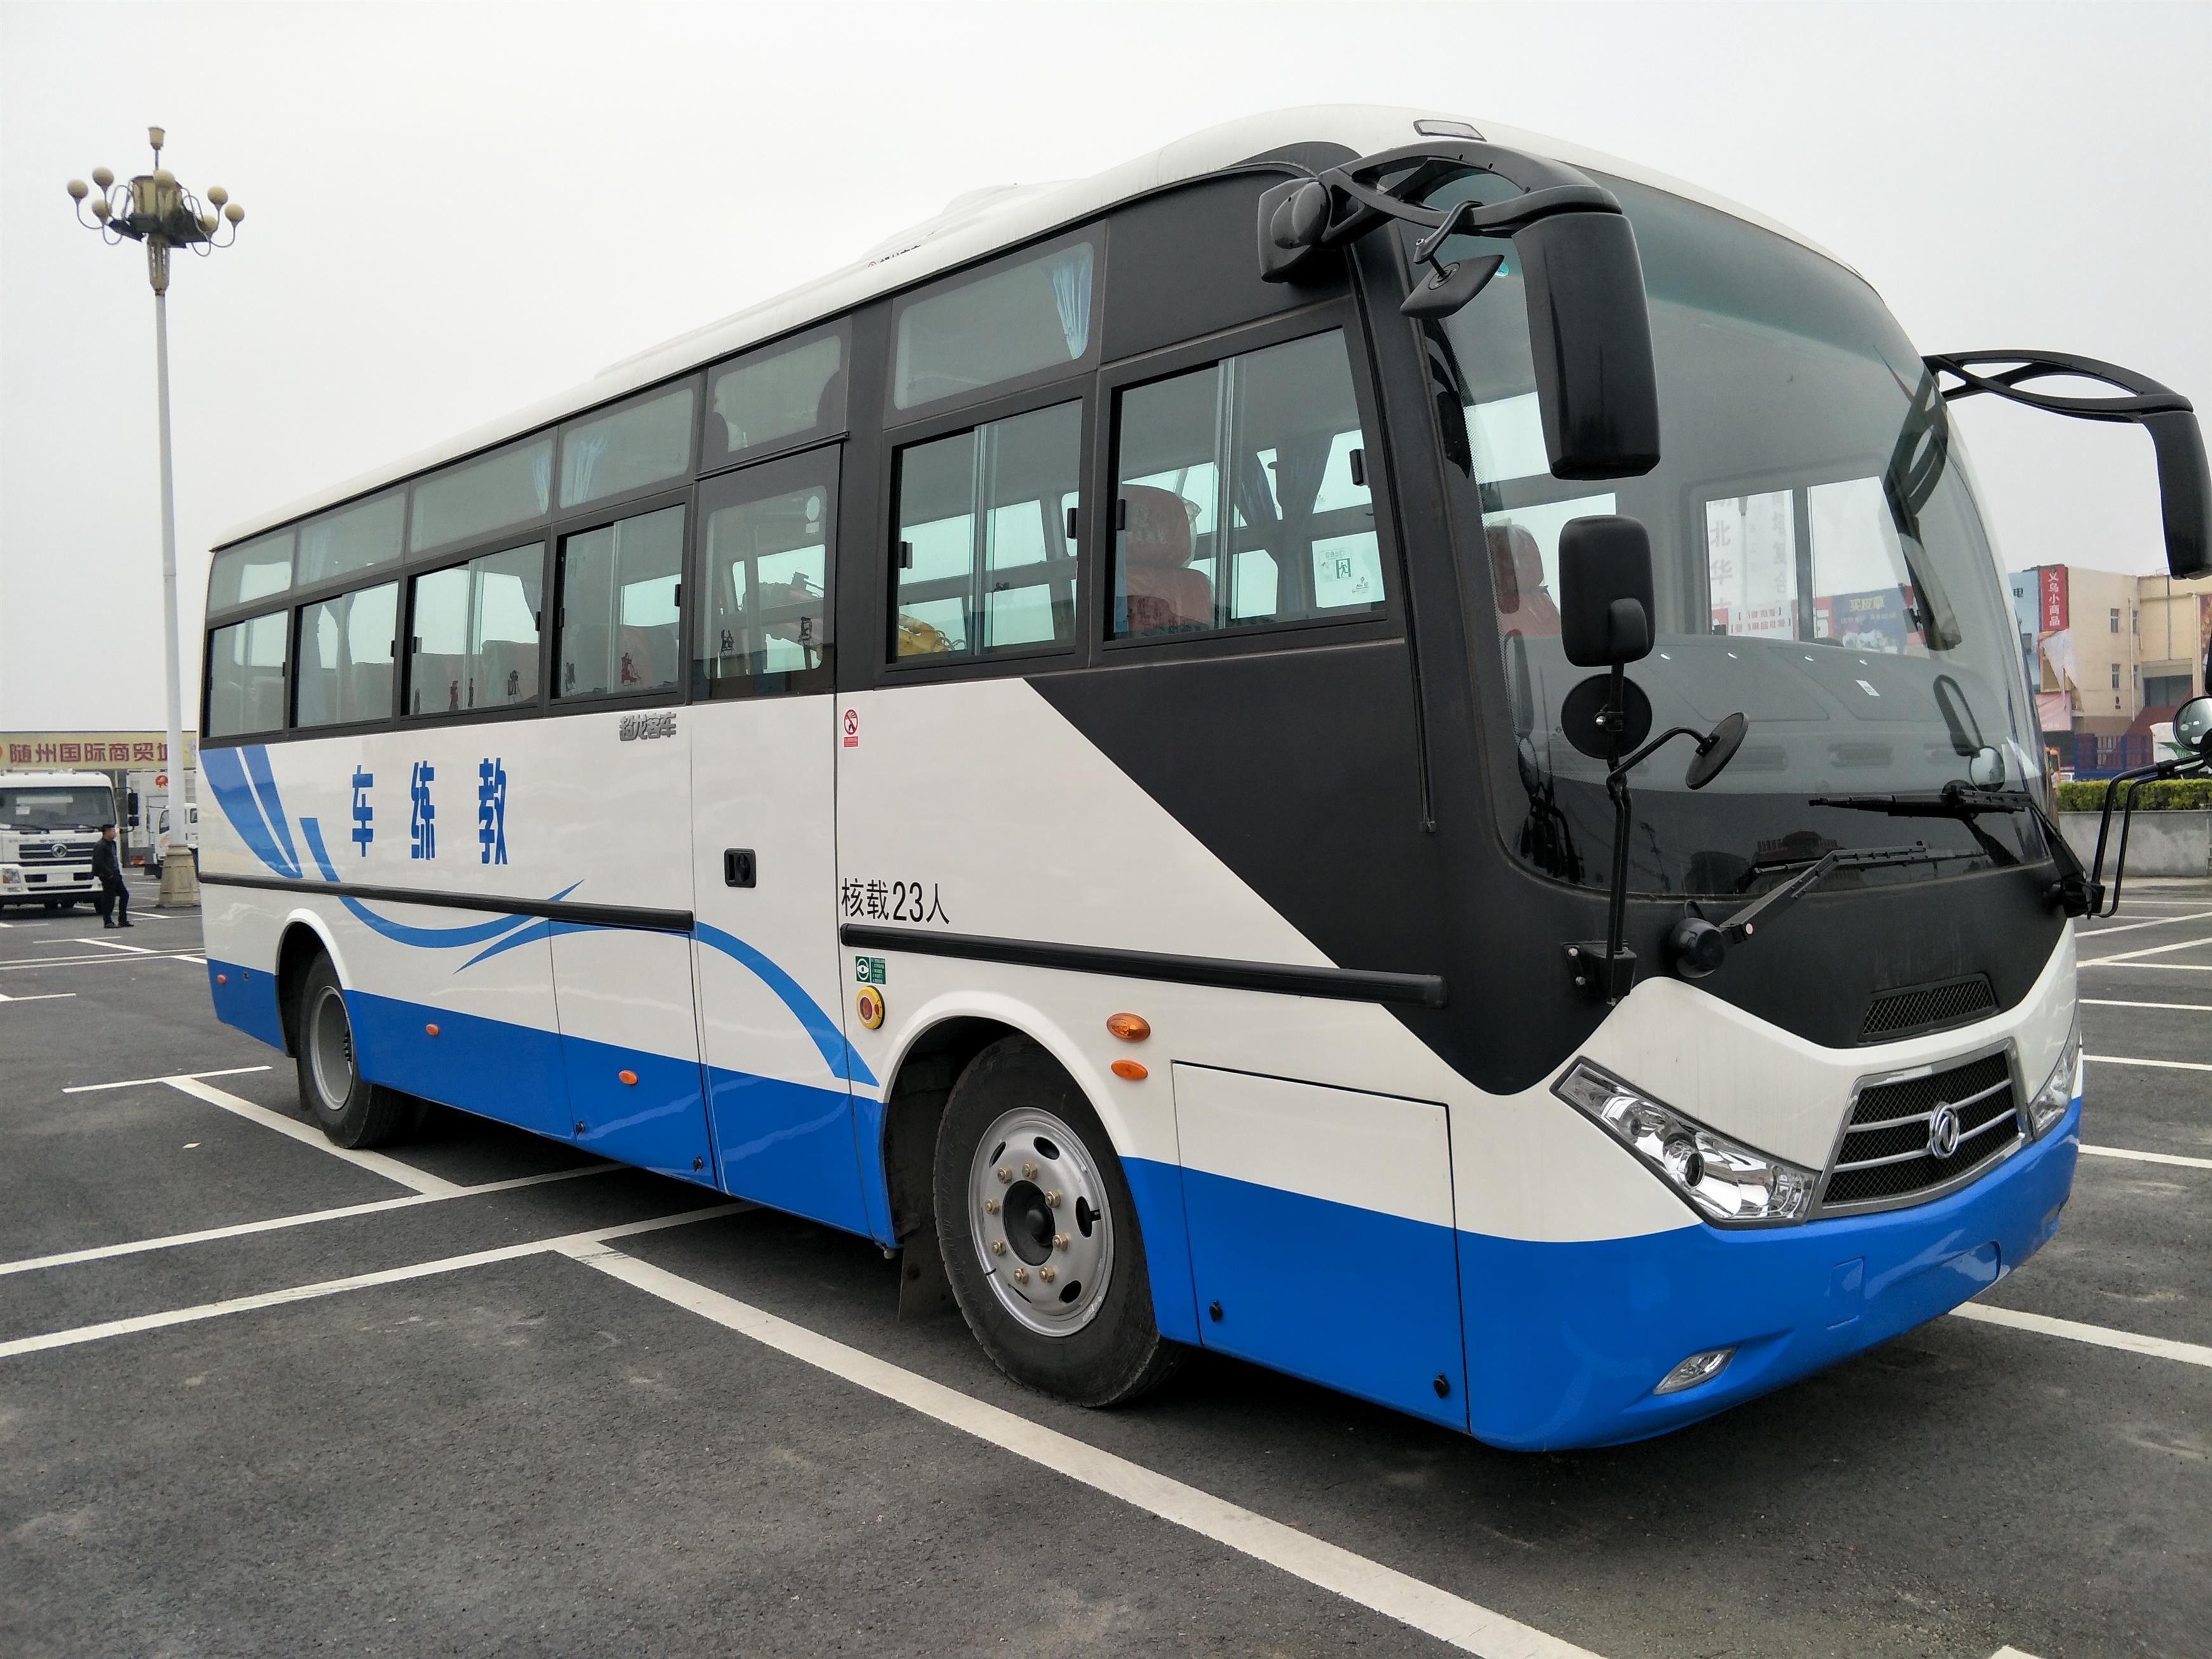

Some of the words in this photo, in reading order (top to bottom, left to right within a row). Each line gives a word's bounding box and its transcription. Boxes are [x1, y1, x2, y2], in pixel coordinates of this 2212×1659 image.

[2048, 571, 2060, 626] 义乌小商品
[619, 711, 676, 741] 超龙客车
[841, 878, 950, 925] 核载23人
